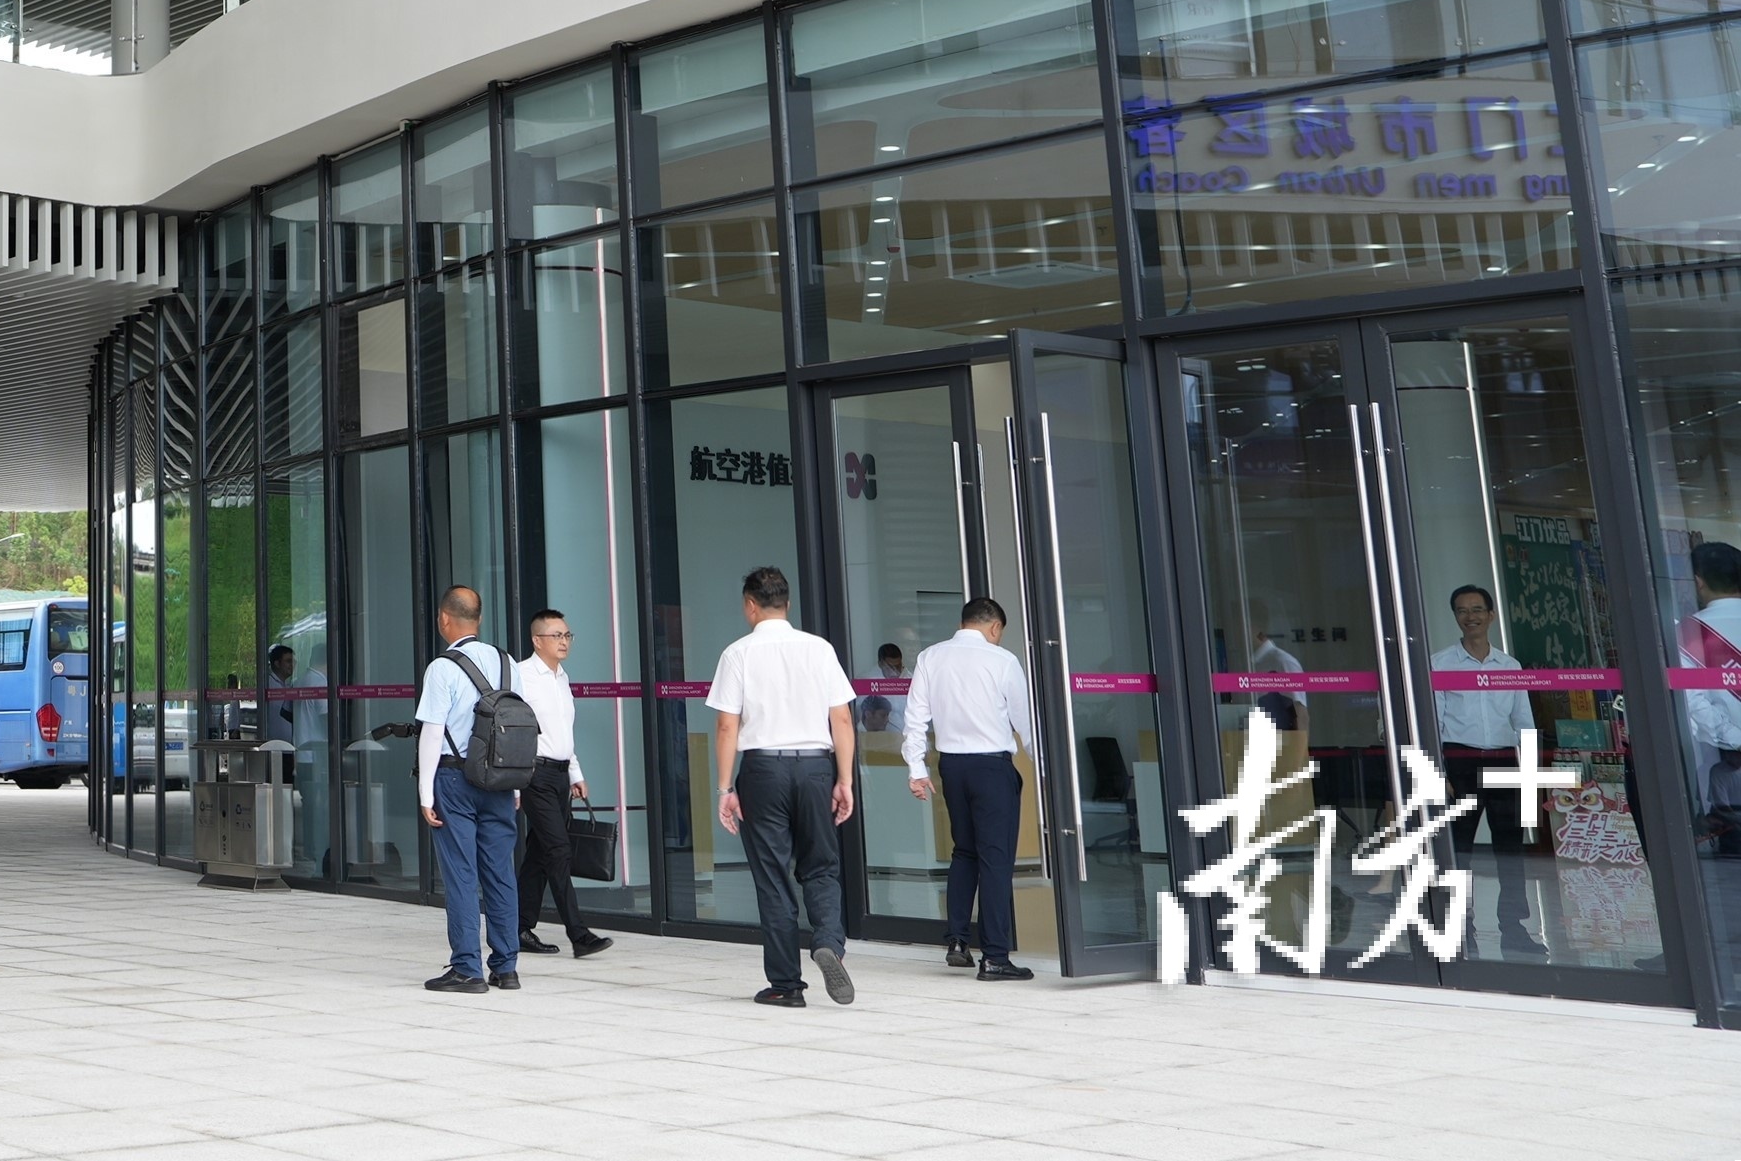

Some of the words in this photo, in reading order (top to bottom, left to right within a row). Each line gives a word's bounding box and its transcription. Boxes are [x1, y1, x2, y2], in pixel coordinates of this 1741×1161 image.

[690, 445, 794, 487] 航空港值
[1291, 627, 1348, 642] 卫生间
